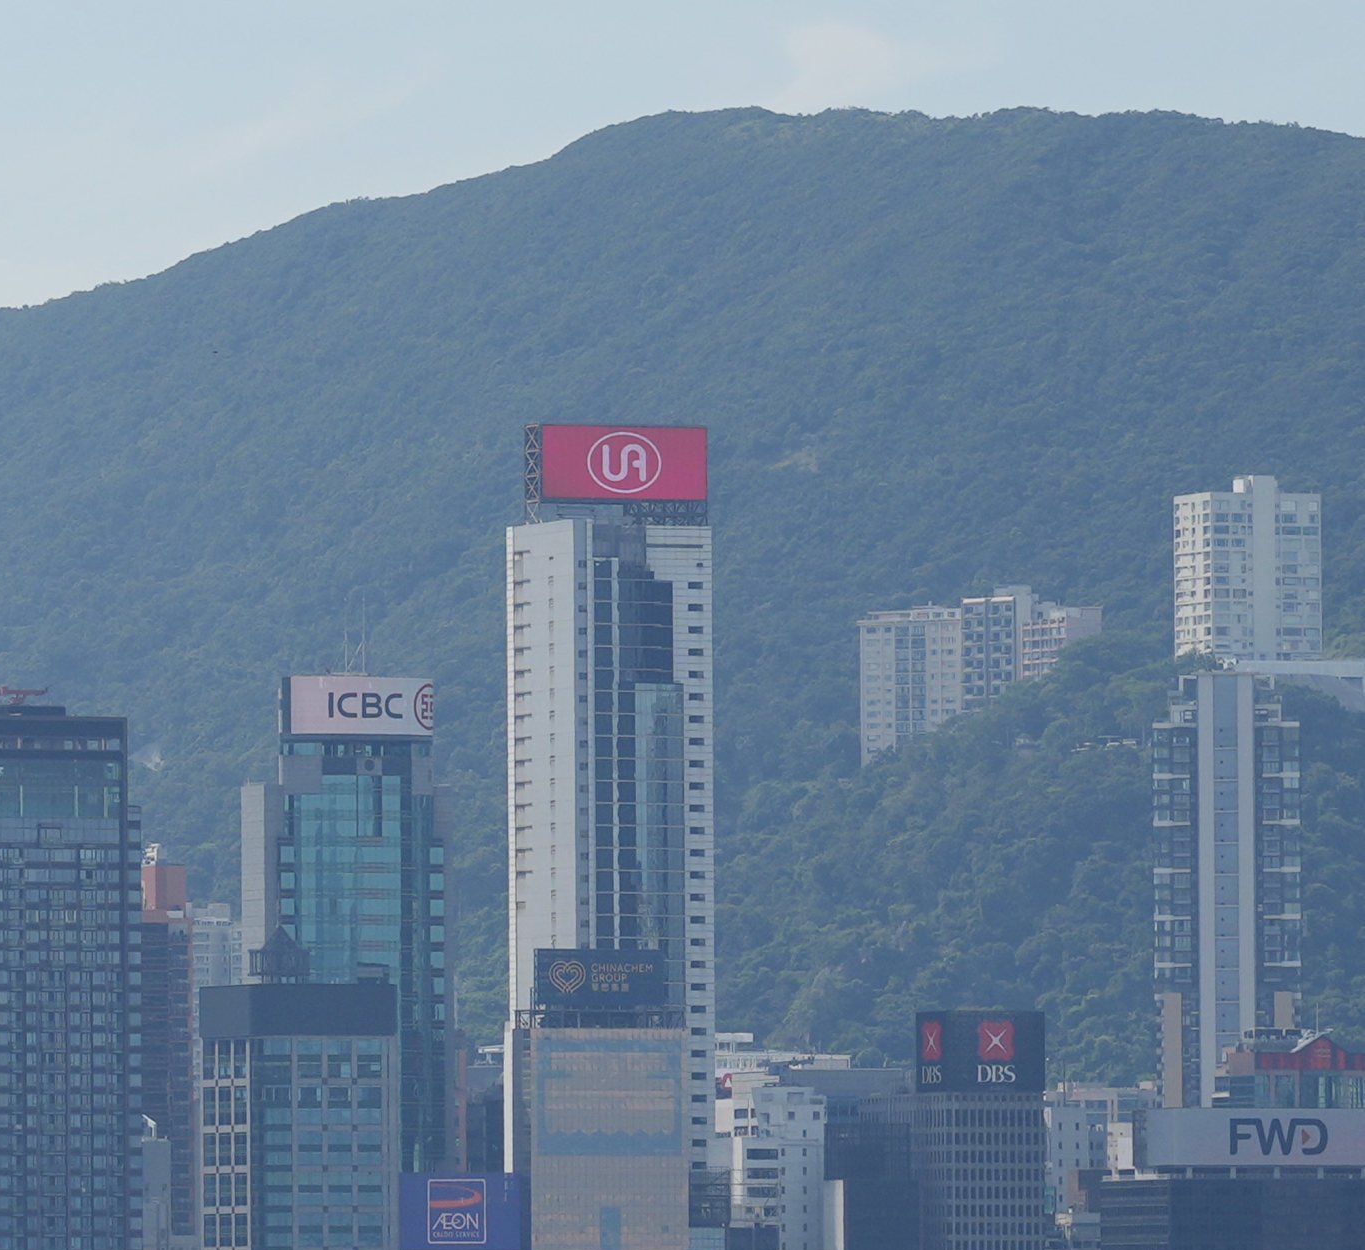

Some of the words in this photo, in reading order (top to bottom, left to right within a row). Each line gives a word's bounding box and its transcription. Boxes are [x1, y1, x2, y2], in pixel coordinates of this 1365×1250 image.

[328, 692, 403, 719] ICBC
[591, 963, 653, 973] CHINACHEM
[591, 973, 628, 983] GROUP
[921, 1065, 942, 1084] DBS
[977, 1064, 1016, 1083] DBS
[1229, 1118, 1329, 1156] FWD
